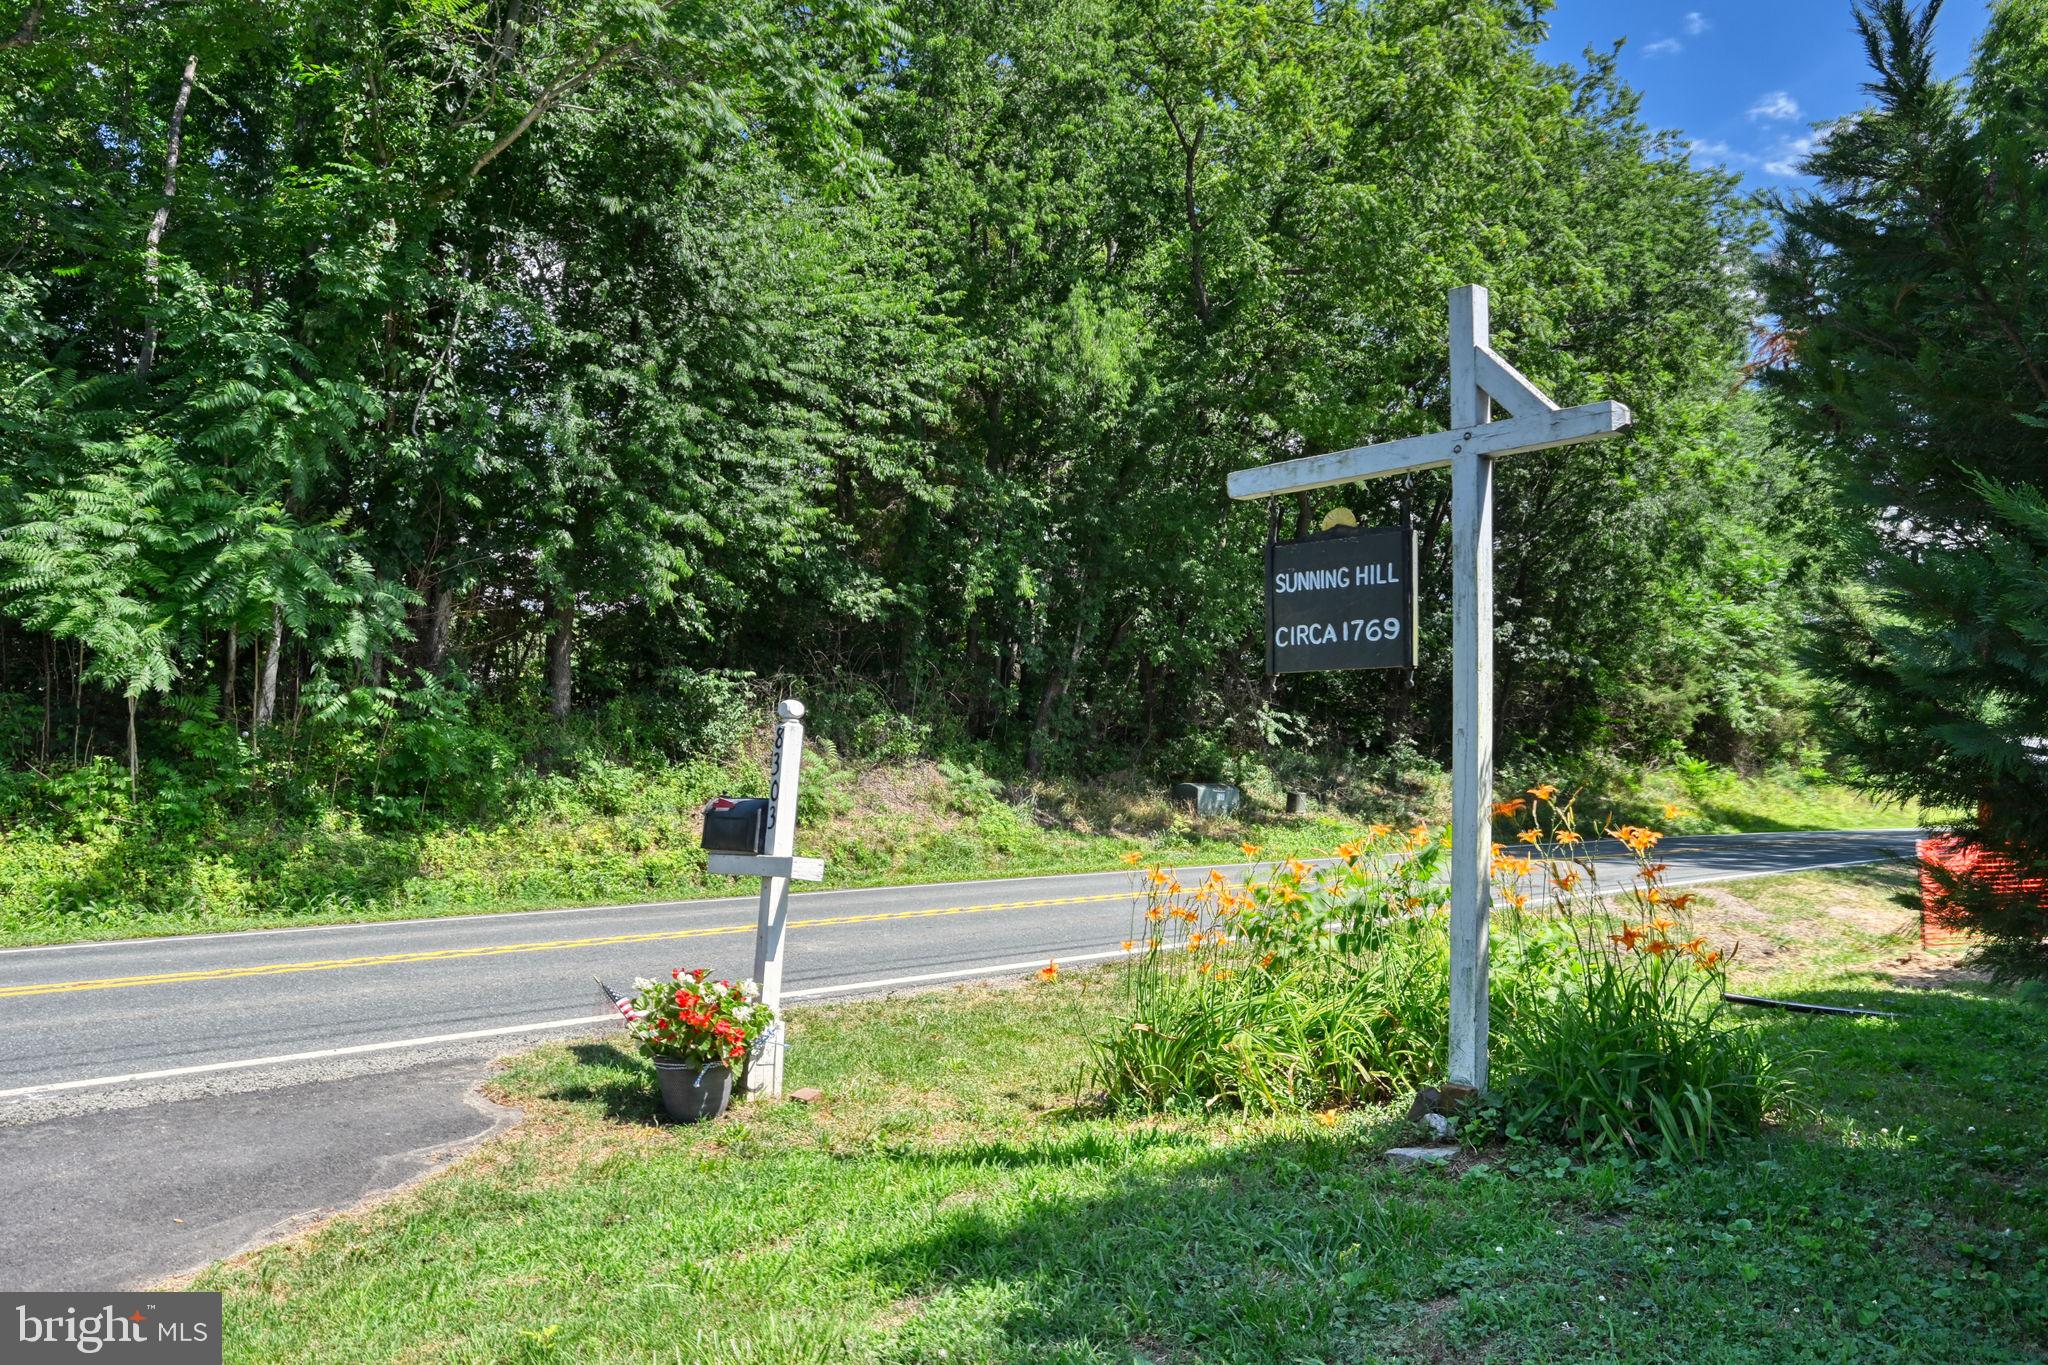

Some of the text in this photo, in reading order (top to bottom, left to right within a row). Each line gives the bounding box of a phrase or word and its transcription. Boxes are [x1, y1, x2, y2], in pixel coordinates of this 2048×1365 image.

[1275, 562, 1400, 594] SUNNING HILL
[1275, 616, 1401, 648] CIRCA 1769
[767, 727, 785, 830] 8303
